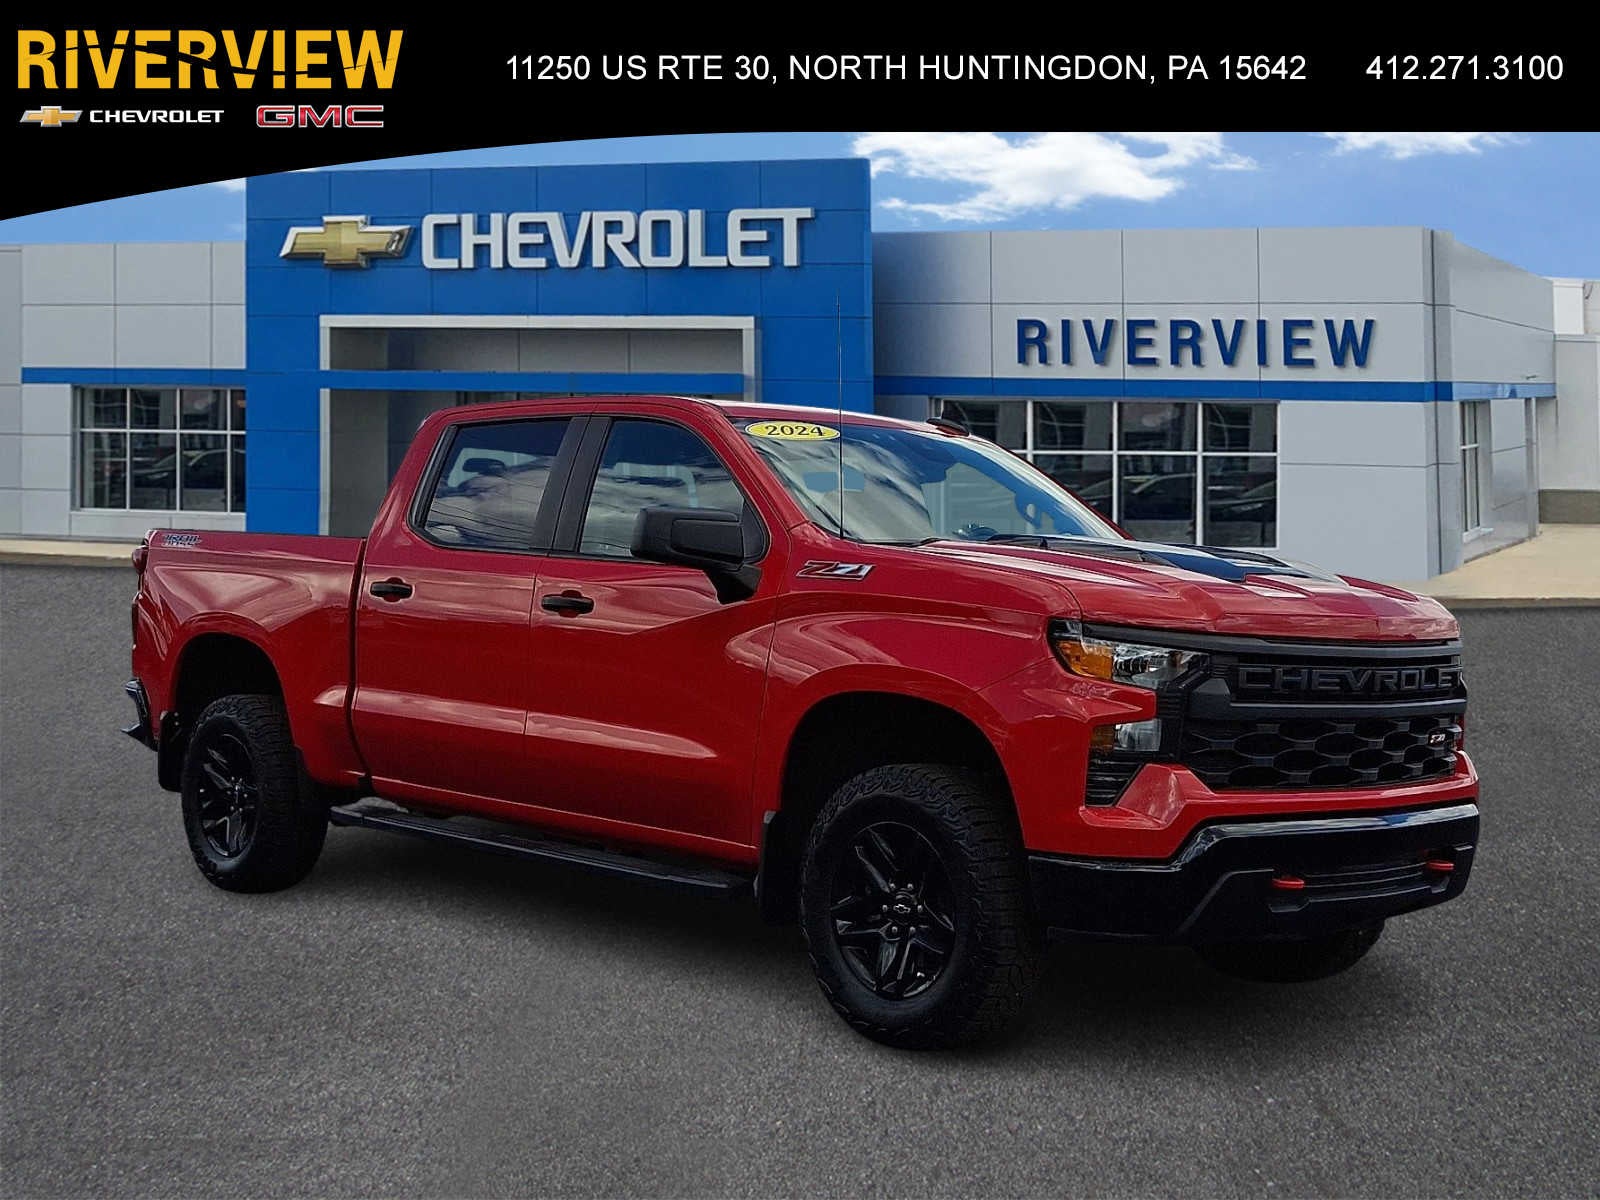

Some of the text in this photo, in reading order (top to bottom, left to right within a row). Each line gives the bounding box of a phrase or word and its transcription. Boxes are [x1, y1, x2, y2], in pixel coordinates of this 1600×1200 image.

[421, 207, 813, 269] CHEVROLET
[1016, 318, 1375, 368] RIVERVIEW
[765, 424, 824, 437] 2024
[796, 560, 876, 581] Z71
